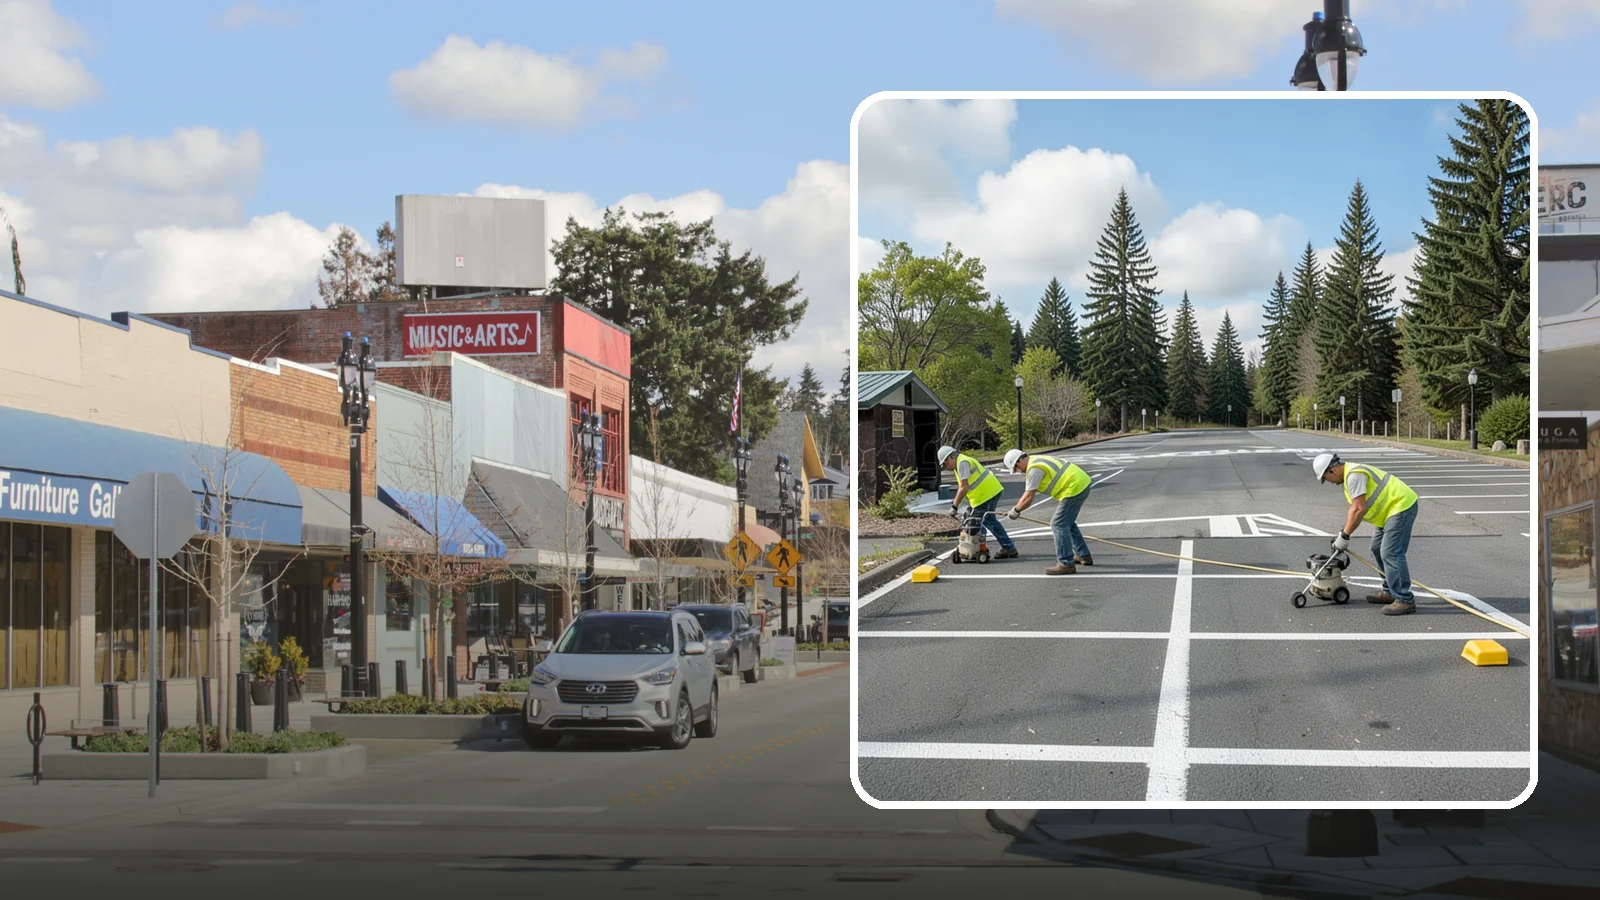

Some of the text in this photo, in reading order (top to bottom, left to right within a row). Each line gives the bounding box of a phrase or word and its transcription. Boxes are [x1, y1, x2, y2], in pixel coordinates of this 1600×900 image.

[408, 322, 520, 349] MUSIC&ARTS
[0, 472, 79, 516] Furniture
[454, 563, 479, 574] SUSHI
